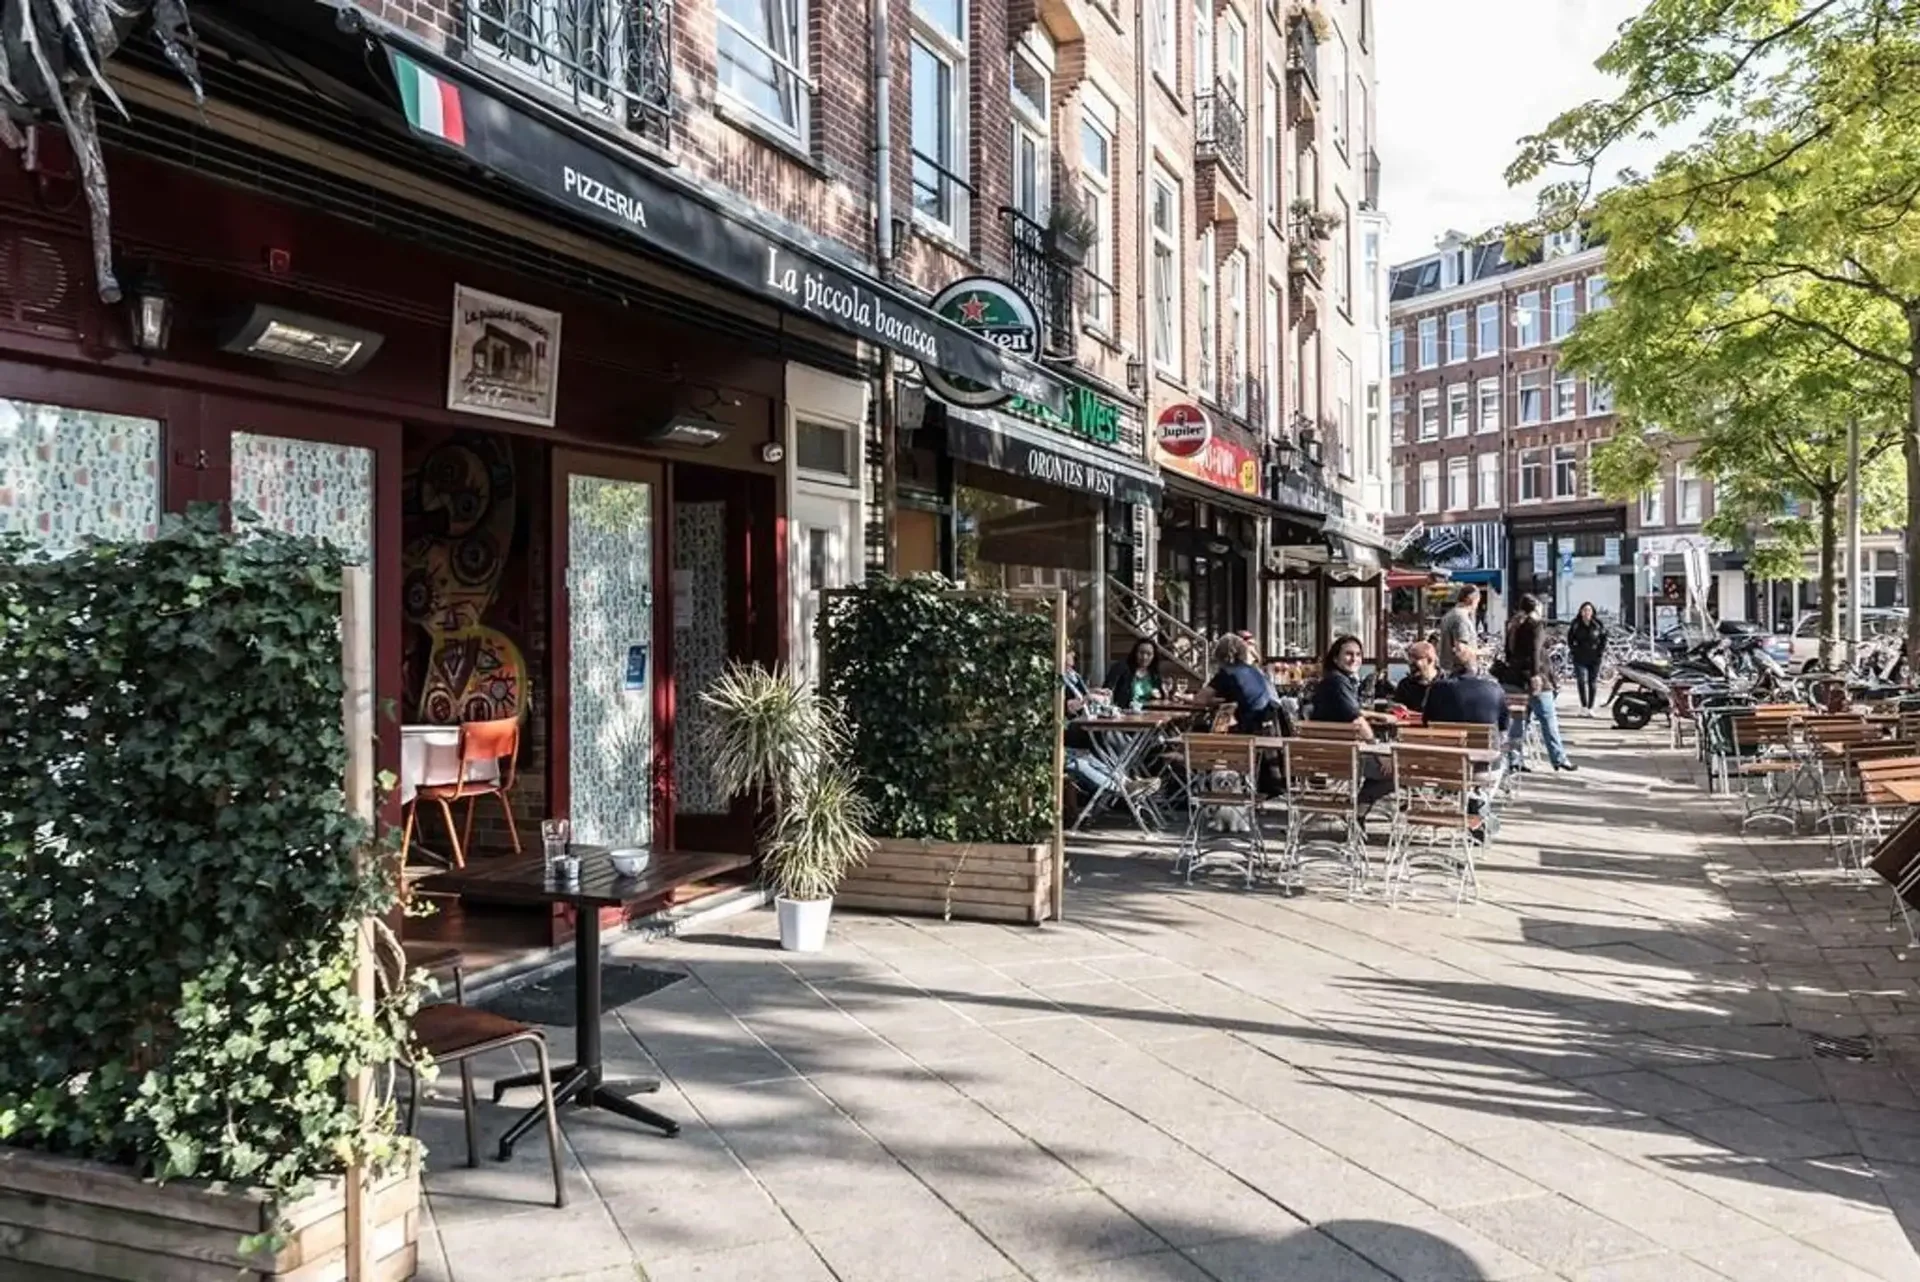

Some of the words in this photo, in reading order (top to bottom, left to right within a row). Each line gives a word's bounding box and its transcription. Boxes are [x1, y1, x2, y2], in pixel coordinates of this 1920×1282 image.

[563, 166, 647, 229] PIZZERIA
[767, 246, 798, 295] La
[803, 273, 872, 329] piccola
[875, 297, 938, 358] baracca
[1161, 425, 1204, 438] Jupiler
[1028, 450, 1084, 487] ORONTES
[1086, 466, 1115, 496] WEST
